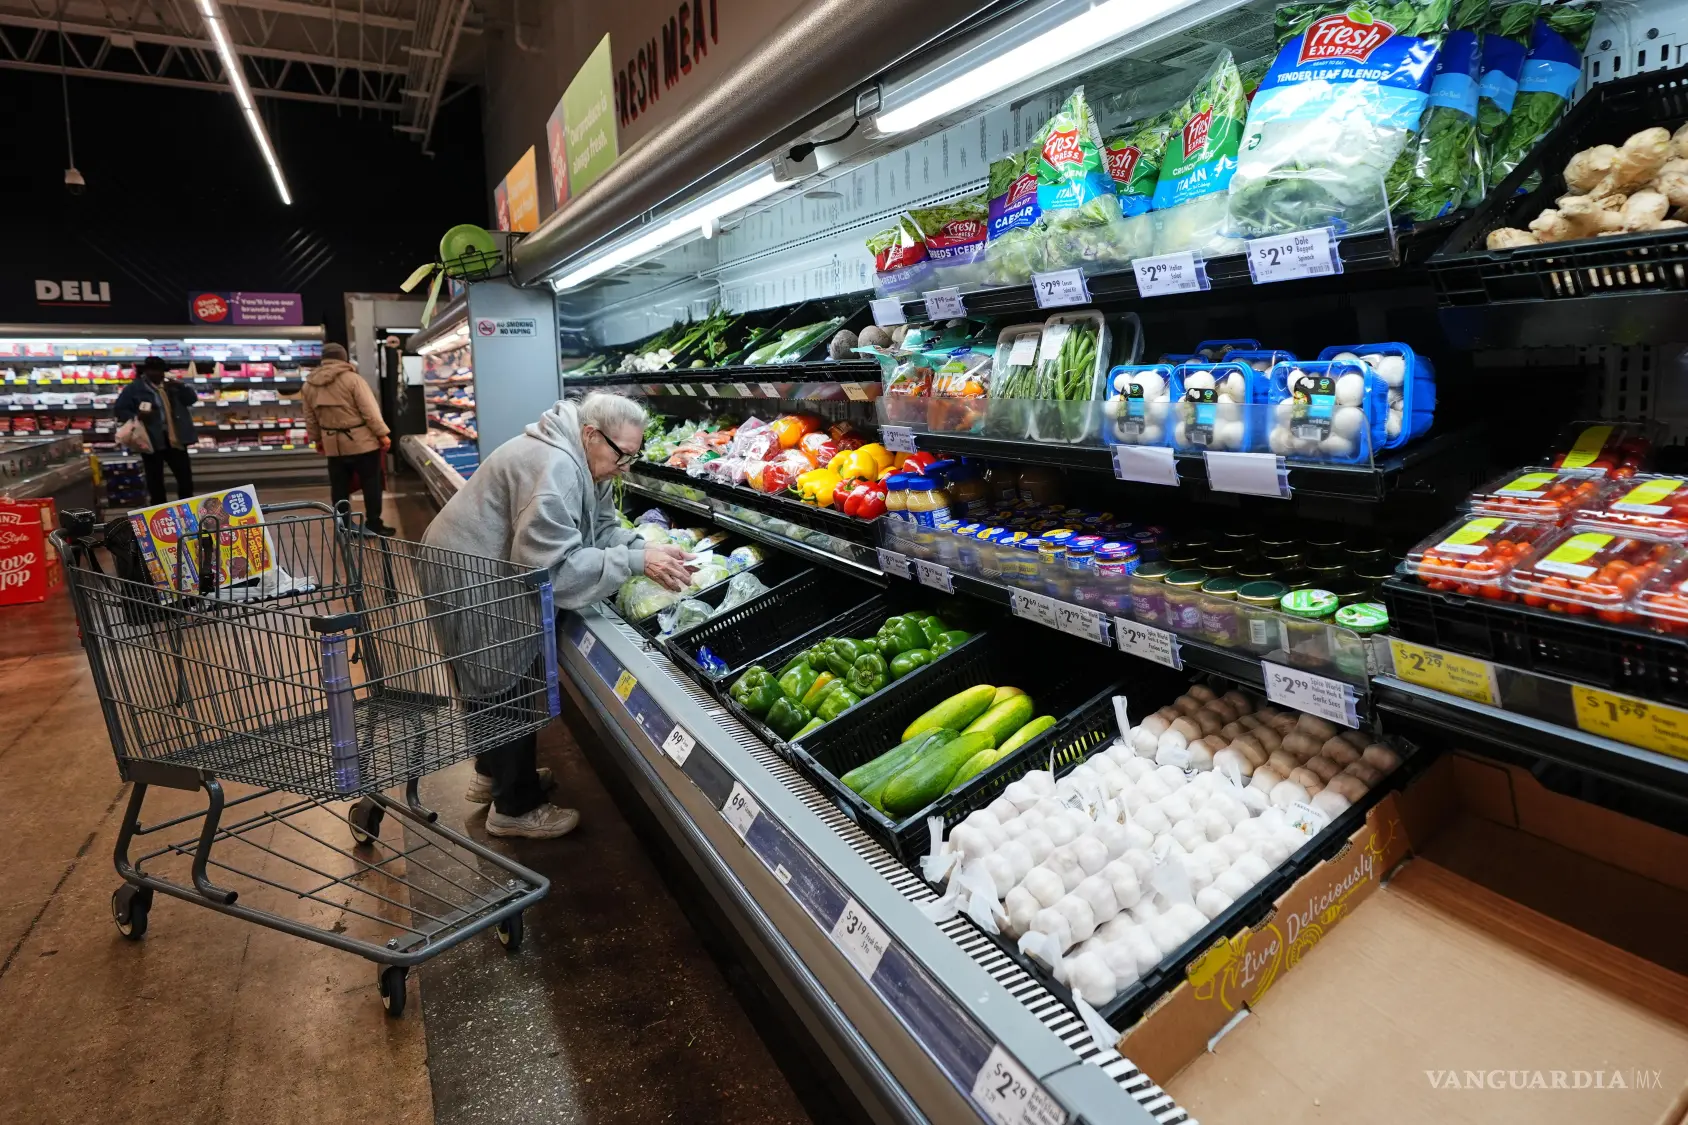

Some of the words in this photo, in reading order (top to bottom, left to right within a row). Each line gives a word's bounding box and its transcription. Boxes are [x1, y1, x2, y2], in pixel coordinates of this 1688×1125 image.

[1310, 19, 1381, 49] Fresh
[1277, 71, 1312, 83] TENDER
[1313, 69, 1341, 81] LEAF
[1341, 68, 1390, 81] BLENDS
[1188, 136, 1207, 152] EXPRE
[994, 206, 1034, 229] CAESAR
[947, 221, 976, 239] Fresh
[1294, 236, 1309, 246] Dole
[35, 279, 111, 301] DELI
[235, 493, 248, 513] save
[130, 520, 141, 537] FREE
[0, 552, 36, 571] ove
[1273, 673, 1308, 694] $299
[1310, 677, 1324, 688] Spice
[1312, 694, 1328, 705] Garlic
[1240, 940, 1280, 988] Live
[1286, 854, 1373, 944] Deliciously
[994, 1063, 1028, 1100] $229
